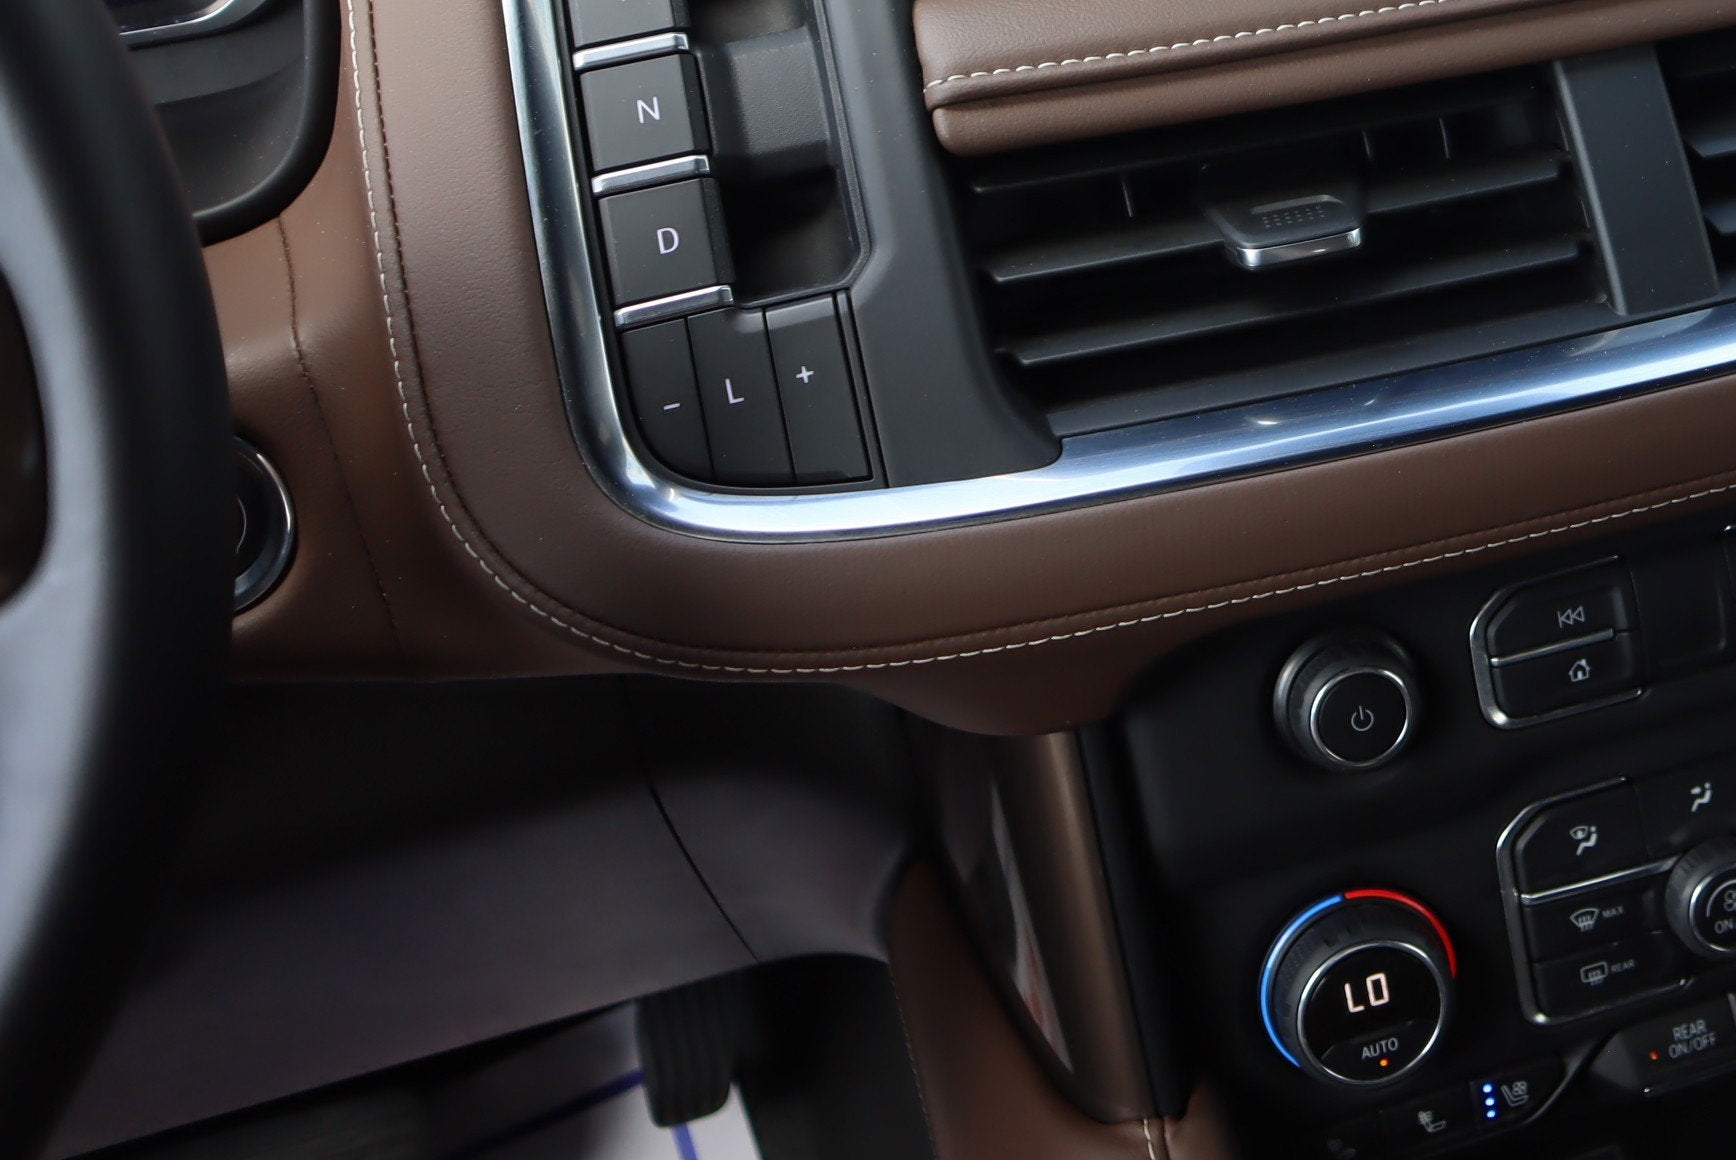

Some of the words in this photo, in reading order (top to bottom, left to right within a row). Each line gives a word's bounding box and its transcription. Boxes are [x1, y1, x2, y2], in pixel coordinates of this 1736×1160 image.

[636, 96, 661, 124] N
[656, 227, 680, 255] D
[725, 378, 745, 404] L
[1601, 904, 1625, 920] MAX
[1609, 958, 1636, 975] REAR
[1344, 972, 1390, 1013] LO
[1672, 1019, 1708, 1042] REAR
[1361, 1038, 1400, 1060] AUTO
[1667, 1032, 1718, 1060] ON/OFF
